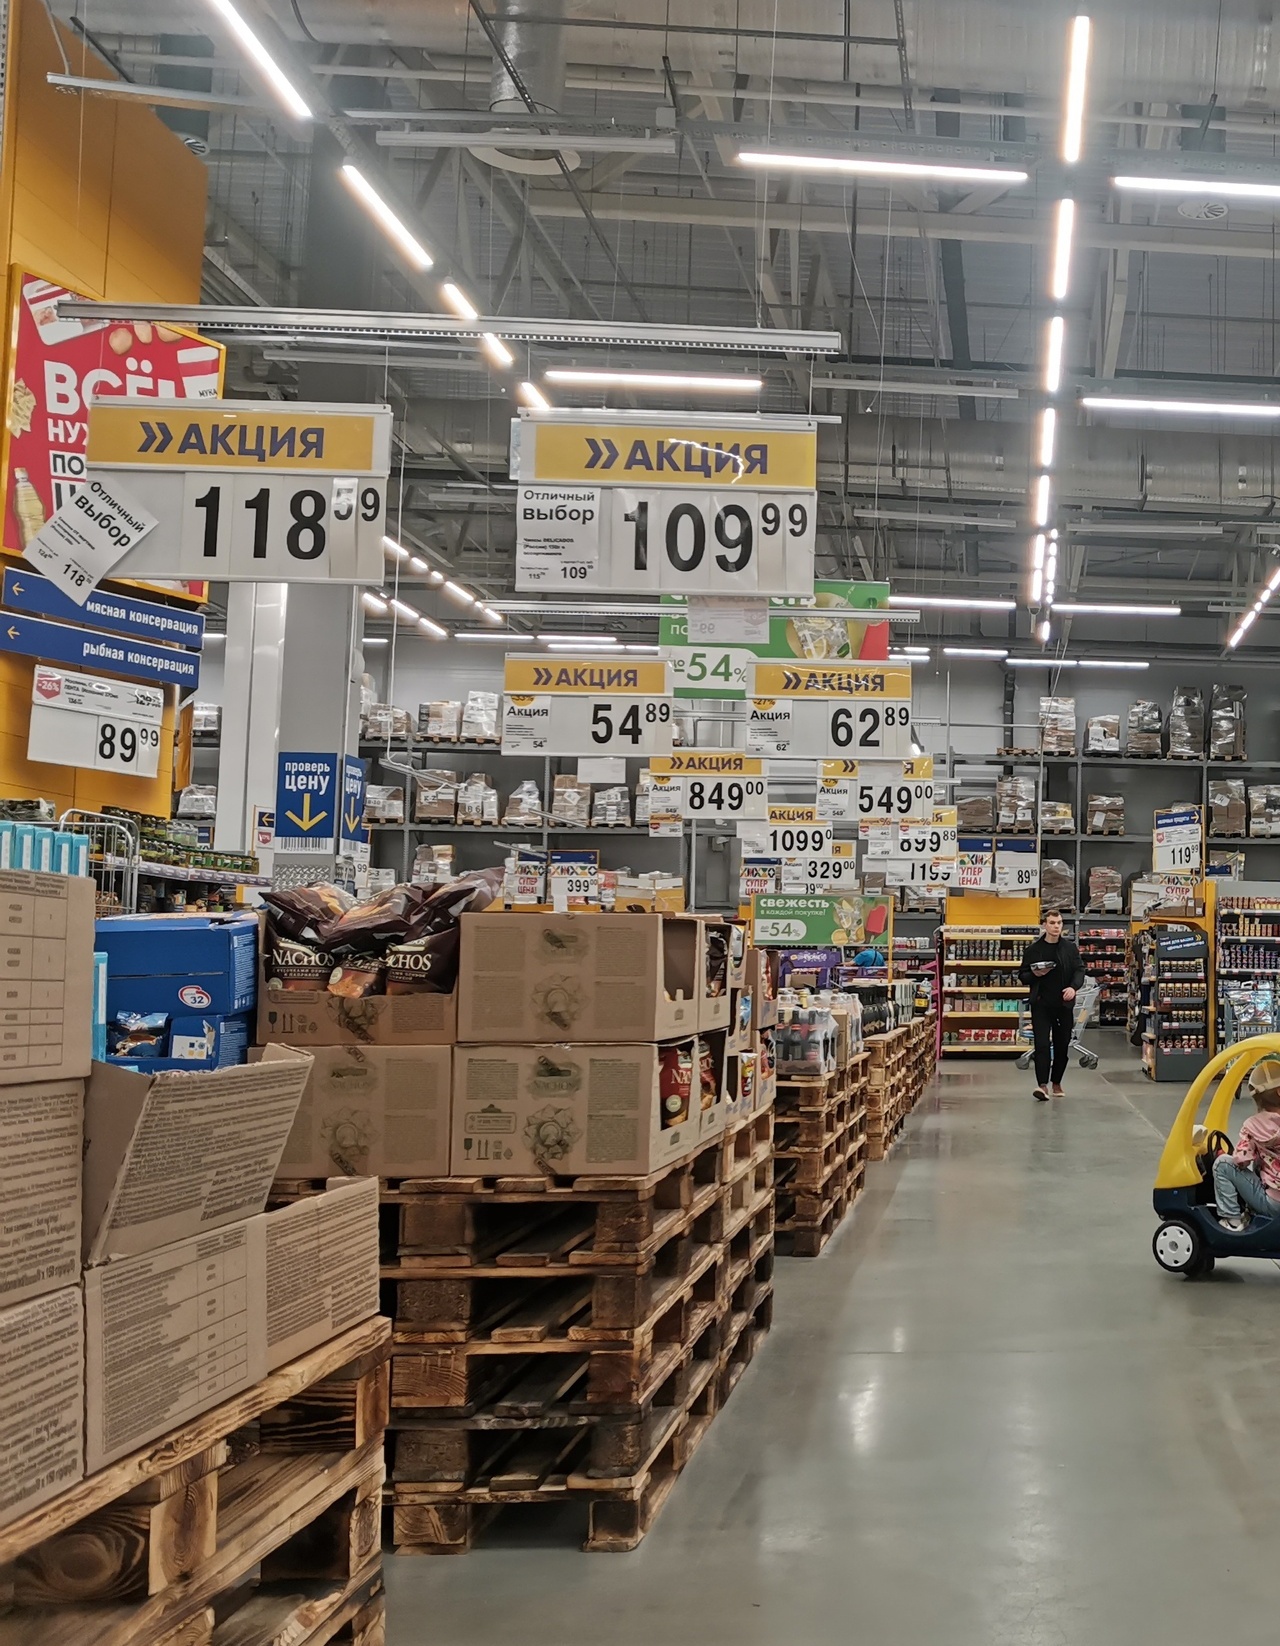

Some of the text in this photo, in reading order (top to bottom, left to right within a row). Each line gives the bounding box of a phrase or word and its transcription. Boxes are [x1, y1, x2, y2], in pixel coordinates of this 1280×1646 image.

[177, 423, 325, 462] АКЦИЯ
[624, 439, 768, 479] АКЦИЯ
[523, 490, 595, 501] Отличный
[90, 481, 147, 534] Отличный
[195, 486, 327, 560] 118
[624, 501, 753, 573] 109
[86, 601, 198, 635] мясная консервация
[83, 642, 195, 675] рыбная консервация
[555, 667, 638, 690] АКЦИЯ
[804, 672, 885, 694] АКЦИЯ
[507, 706, 549, 718] Акция
[750, 710, 791, 722] Акция
[591, 703, 670, 745] 54 89
[831, 706, 910, 747] 62 89
[99, 723, 137, 762] 89
[285, 762, 331, 775] проверь
[685, 757, 743, 772] АКЦИЯ
[285, 774, 330, 796] цену
[652, 784, 681, 793] Акция
[819, 786, 848, 795] Акция
[689, 781, 764, 811] 849 00
[859, 785, 933, 814] 549 00
[769, 809, 814, 821] АКЦИЯ
[769, 829, 824, 852] 1099
[943, 830, 957, 841] 89
[1171, 846, 1191, 865] 119
[808, 861, 843, 879] 329
[1017, 869, 1030, 884] 89
[519, 877, 538, 886] СУПЕР
[567, 879, 590, 892] 399
[745, 879, 768, 888] СУПЕР
[1165, 886, 1190, 894] СУПЕР
[760, 898, 830, 908] свежесть
[795, 909, 826, 917] покупке!
[271, 949, 335, 966] NACHOS
[190, 995, 205, 1005] 32
